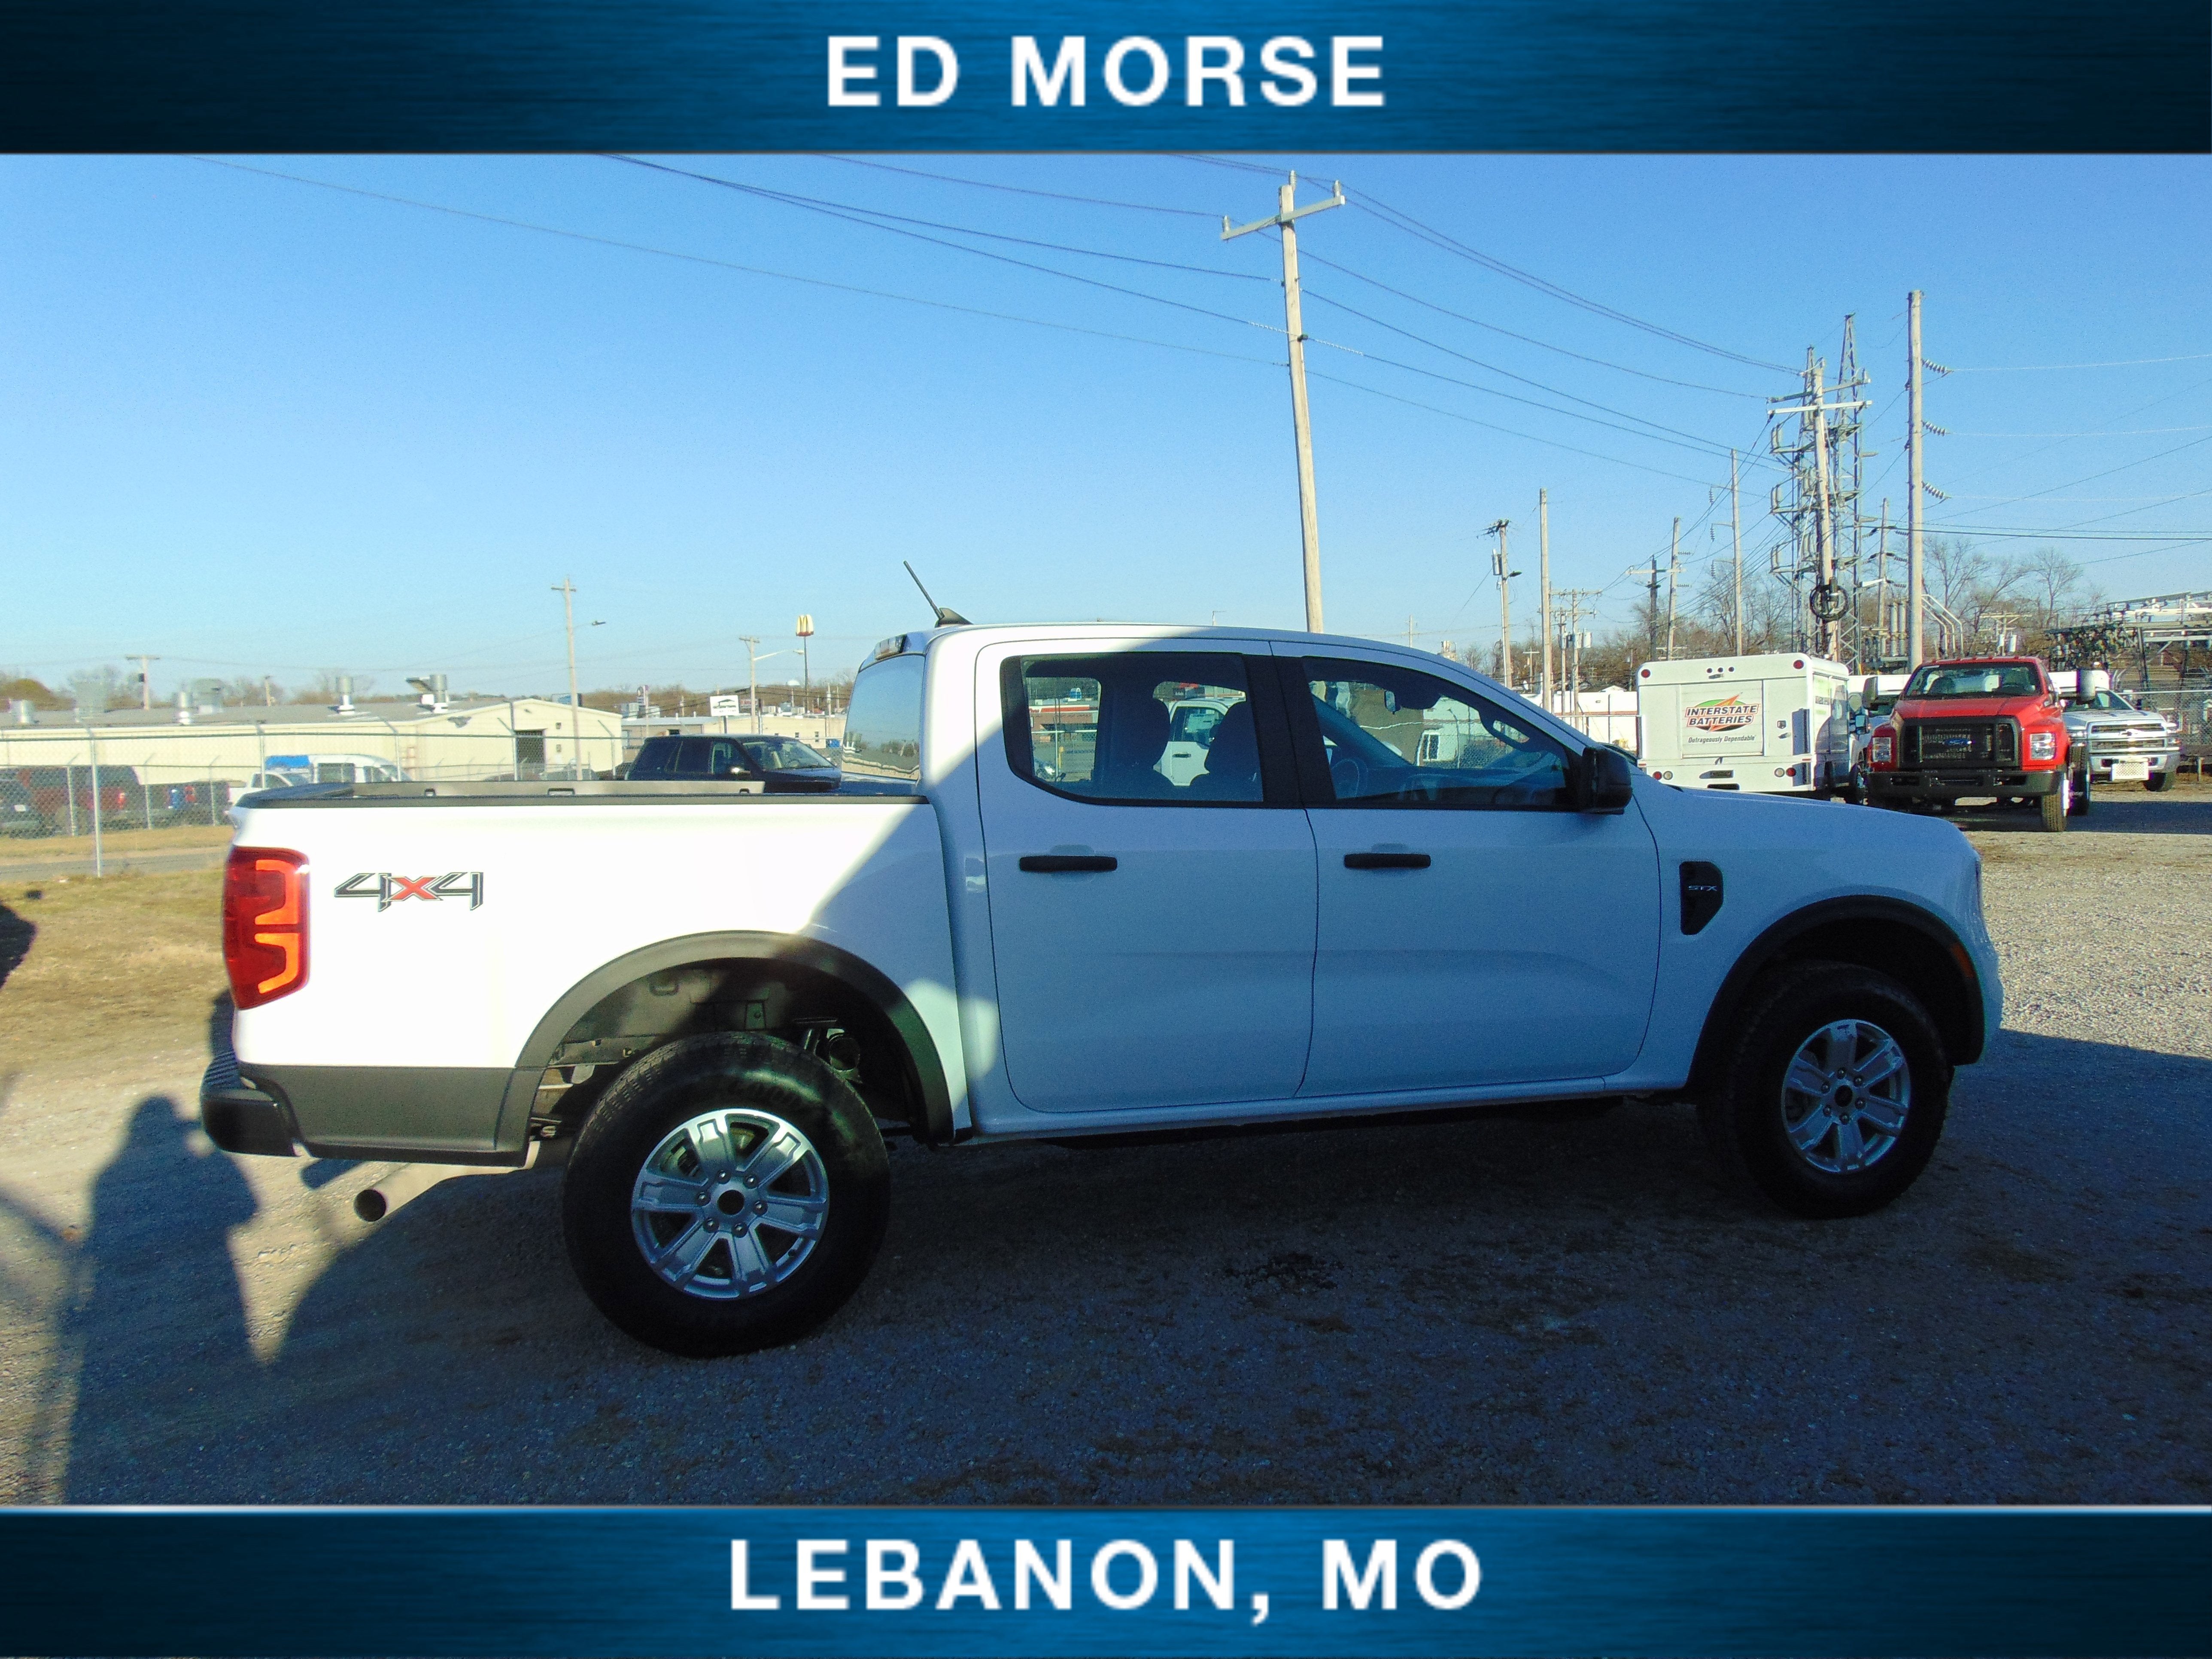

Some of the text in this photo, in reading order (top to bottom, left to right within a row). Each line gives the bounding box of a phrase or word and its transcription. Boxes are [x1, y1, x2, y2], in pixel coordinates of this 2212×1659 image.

[1686, 705, 1757, 716] INTERSTATE
[1689, 715, 1752, 725] BATTERIES
[1688, 736, 1722, 744] Outrageously
